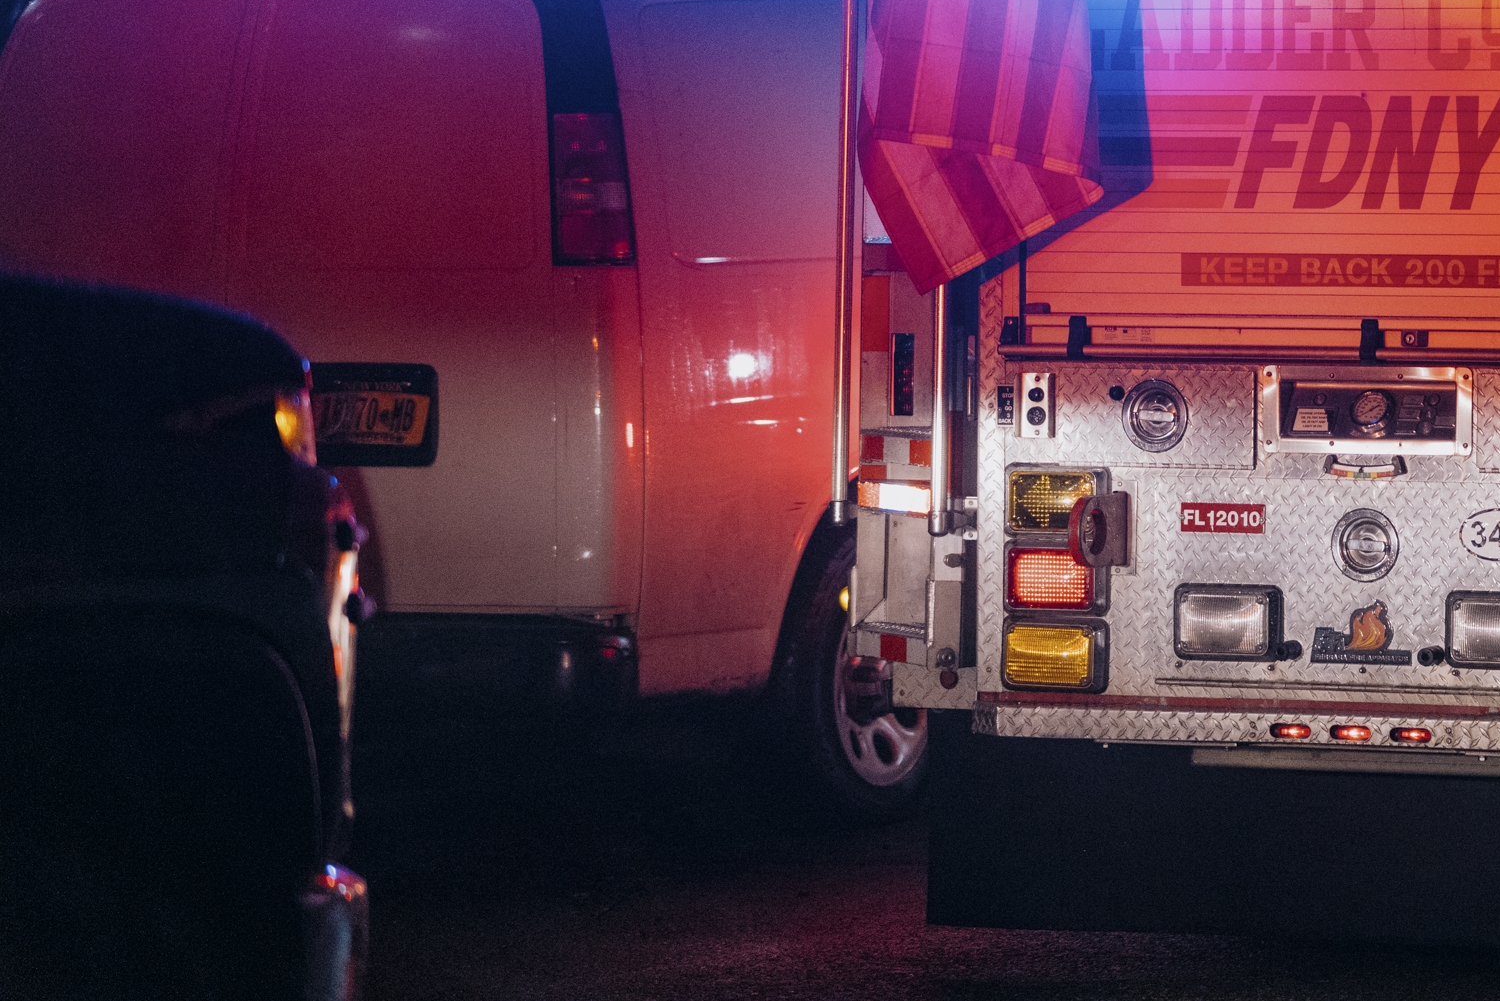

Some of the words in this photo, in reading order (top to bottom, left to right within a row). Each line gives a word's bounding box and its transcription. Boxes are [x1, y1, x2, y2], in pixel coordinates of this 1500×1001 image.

[1199, 256, 1289, 284] KEEP
[1300, 257, 1394, 285] BACK
[1405, 258, 1465, 286] 200
[1183, 508, 1261, 528] FL12010
